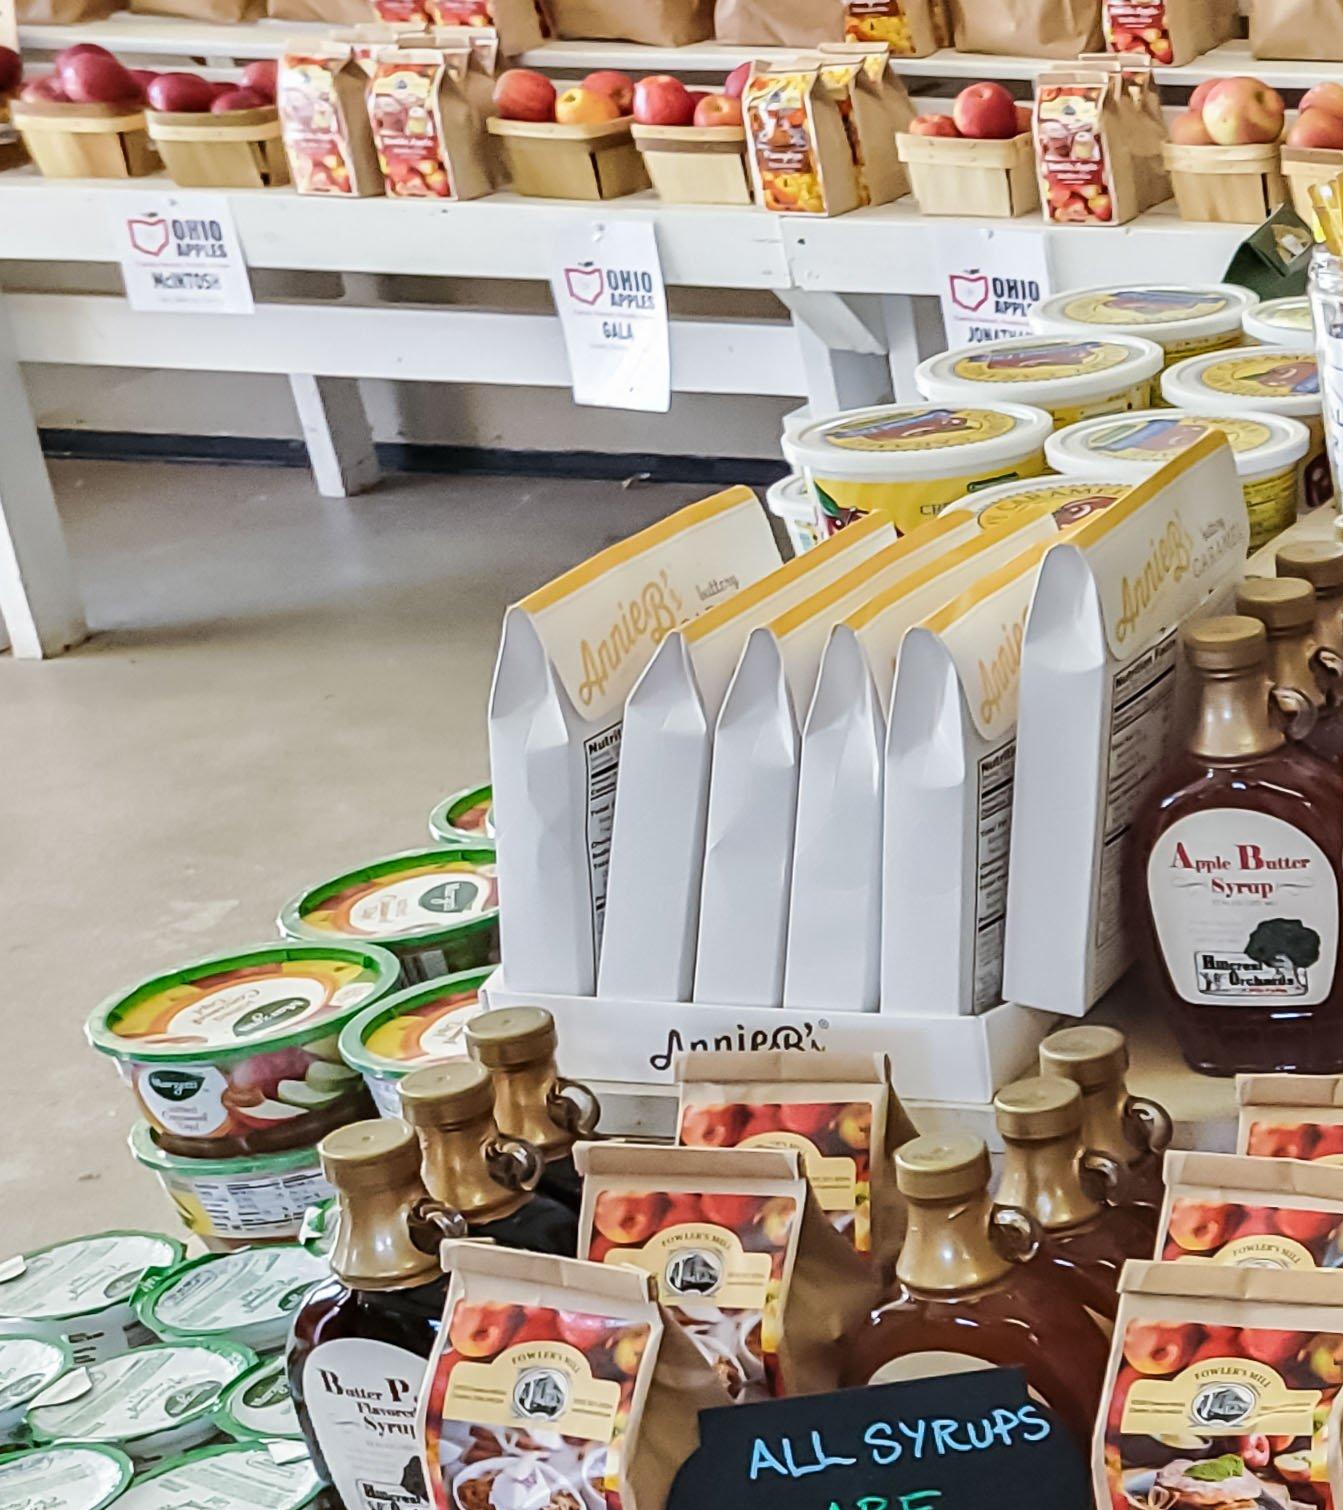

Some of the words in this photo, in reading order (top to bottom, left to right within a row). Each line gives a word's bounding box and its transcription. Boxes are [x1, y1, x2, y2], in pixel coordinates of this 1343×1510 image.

[607, 270, 652, 292] OHIO
[992, 278, 1039, 301] OHIO
[1170, 842, 1231, 873] Apple
[1236, 844, 1310, 870] Butter
[1211, 877, 1273, 898] Syrup
[750, 1431, 856, 1479] ALL
[864, 1405, 1050, 1465] SYRUPS
